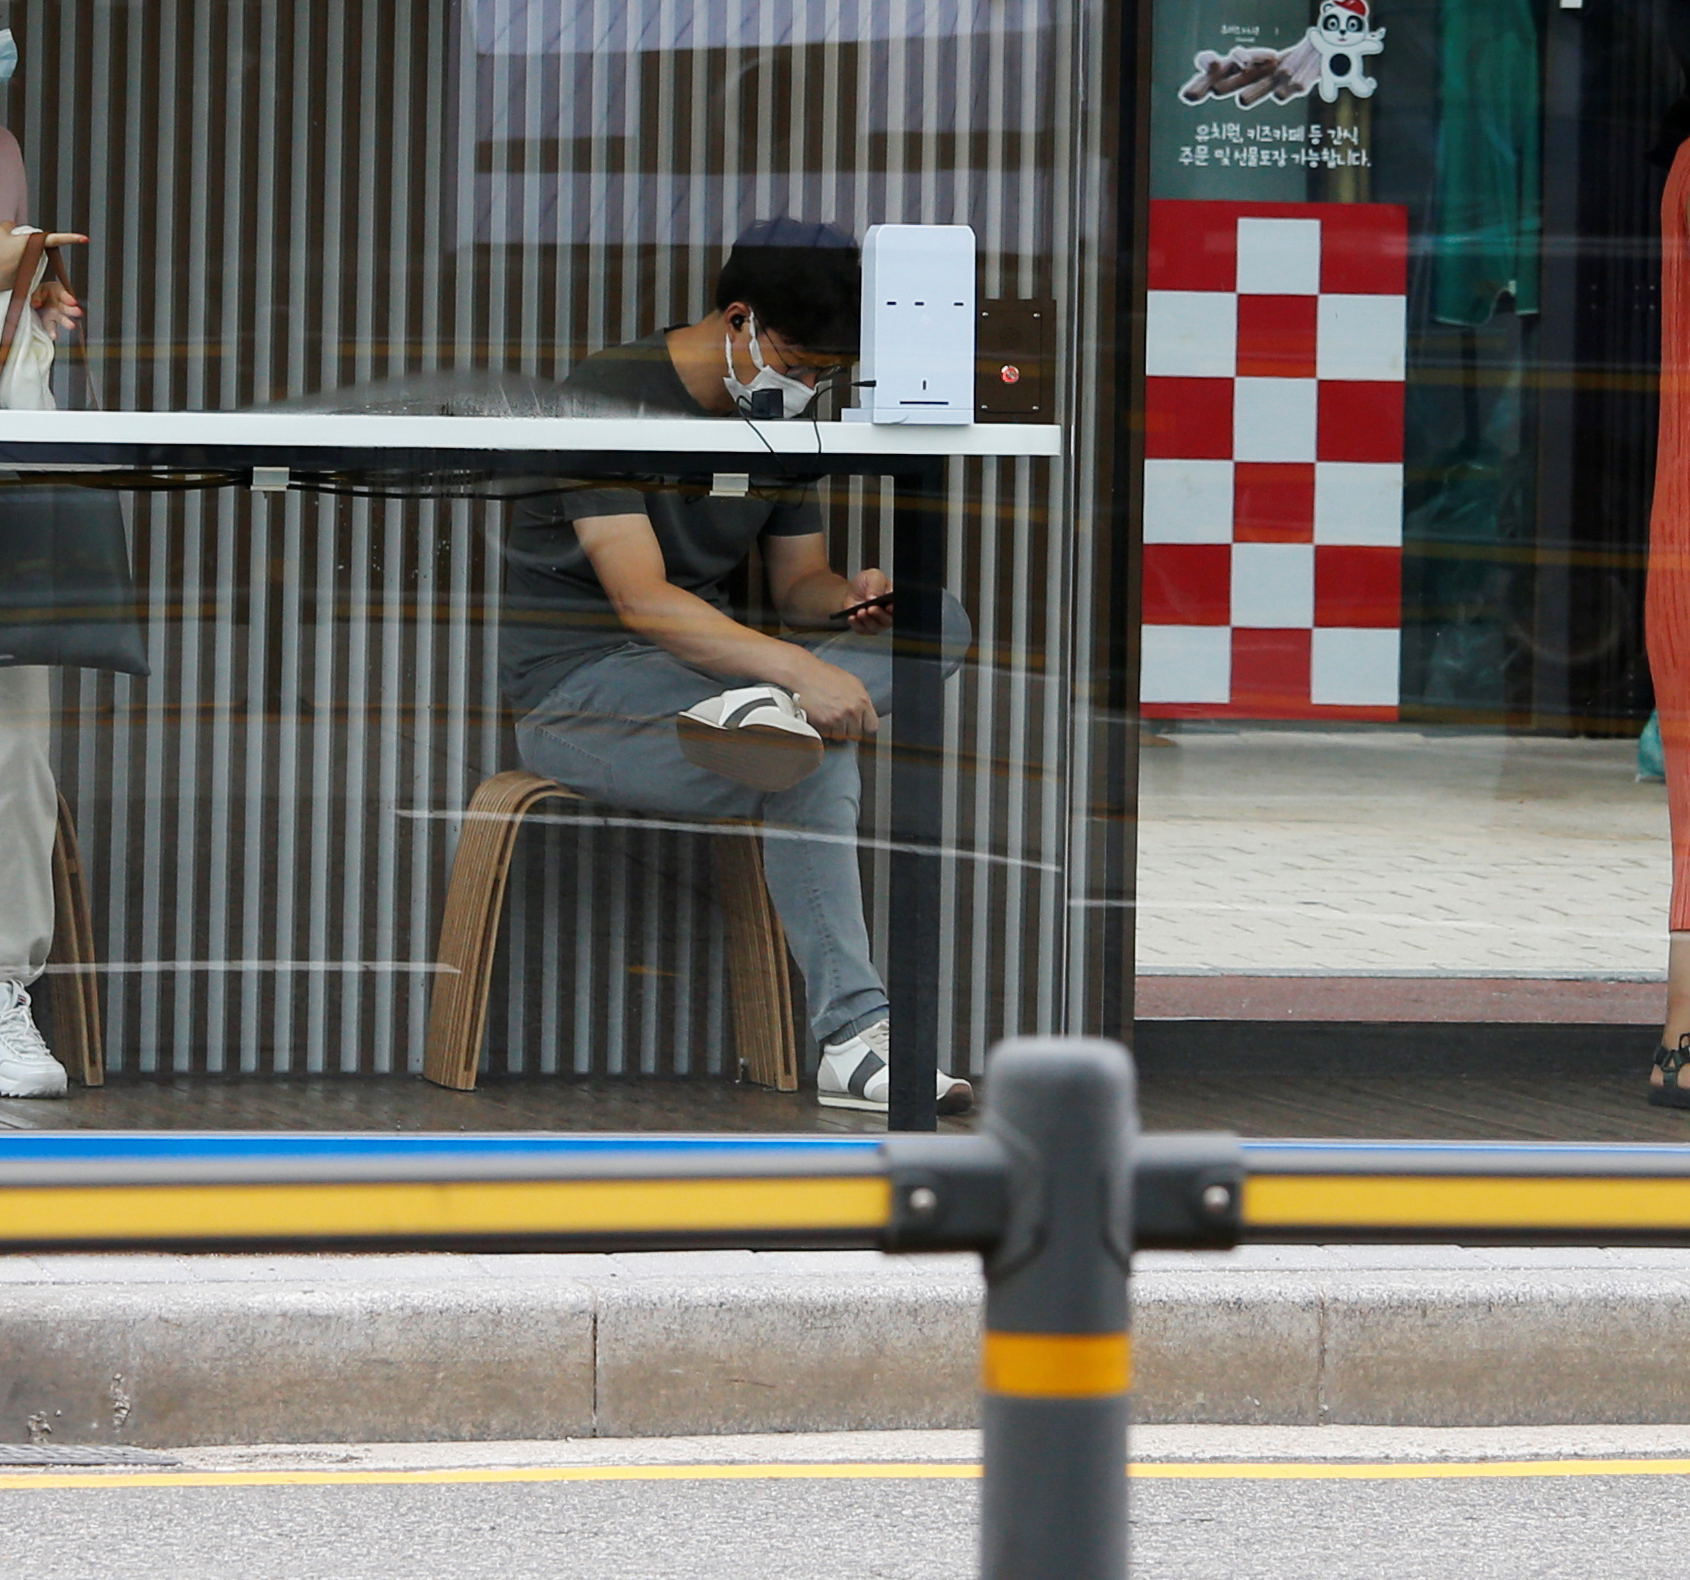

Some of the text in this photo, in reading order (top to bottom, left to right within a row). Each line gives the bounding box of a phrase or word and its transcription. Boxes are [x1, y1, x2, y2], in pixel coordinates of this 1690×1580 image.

[1308, 124, 1324, 145] 등
[1326, 125, 1359, 146] 간식
[1178, 145, 1210, 167] 주문
[1290, 147, 1372, 169] 가능합니다.
